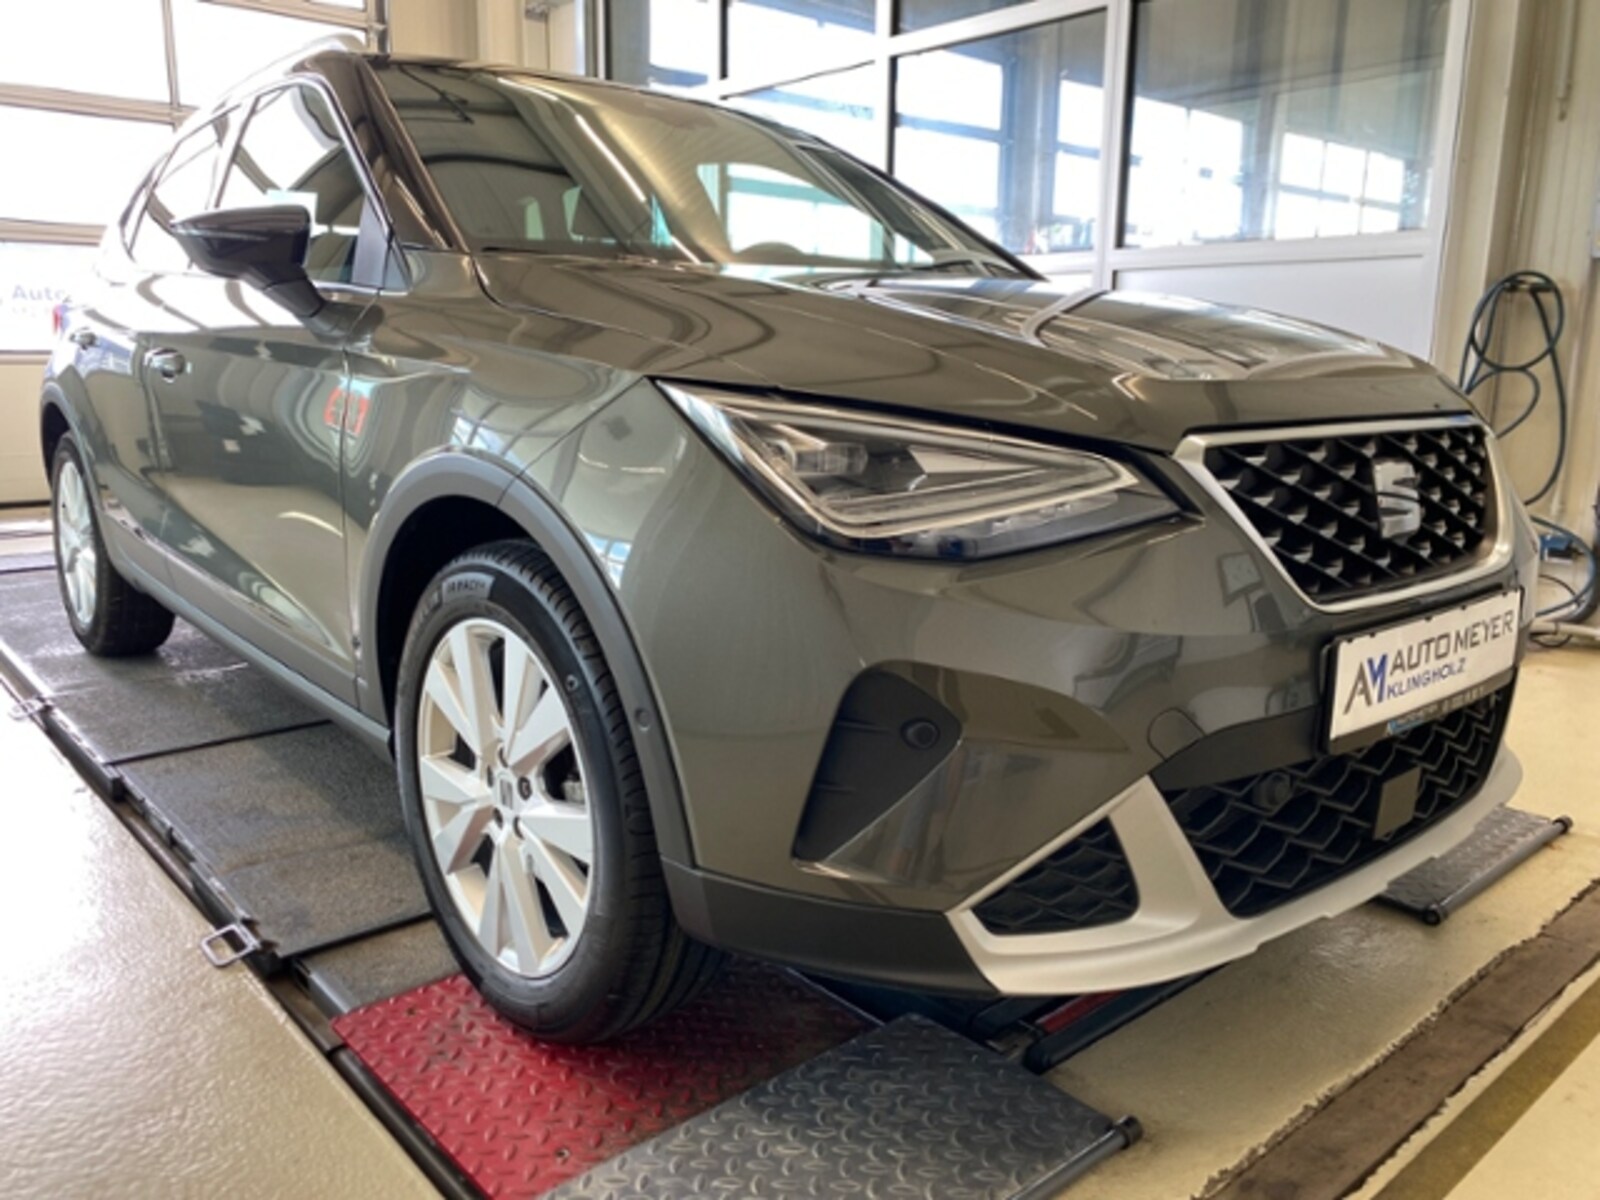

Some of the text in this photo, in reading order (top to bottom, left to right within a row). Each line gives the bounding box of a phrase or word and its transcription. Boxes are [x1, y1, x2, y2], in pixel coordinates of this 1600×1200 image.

[1390, 610, 1514, 676] AUTO MEYER
[1386, 657, 1466, 699] KLINGHOLZ
